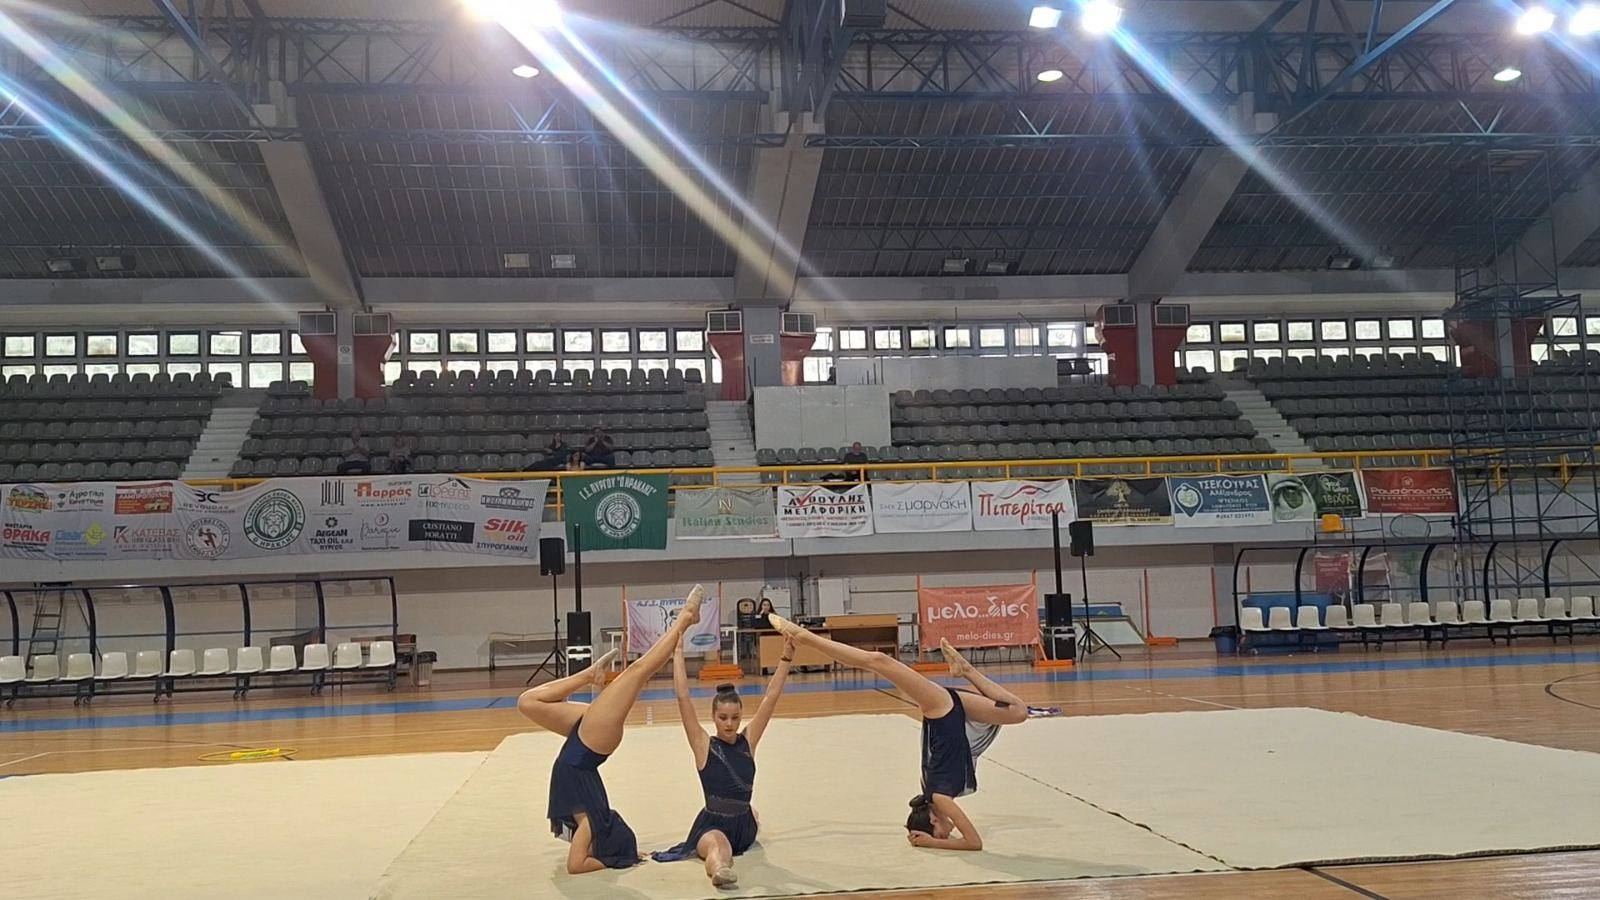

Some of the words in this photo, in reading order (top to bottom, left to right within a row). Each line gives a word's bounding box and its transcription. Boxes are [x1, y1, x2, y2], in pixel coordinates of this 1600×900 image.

[590, 478, 617, 494] ΠΥΡΓΟΥ
[1198, 479, 1260, 490] ΤΣΕΚΟΥΡΑΣ
[784, 505, 866, 515] ΜΕΤΑΦΟΡΙΚΗ
[484, 518, 528, 534] Silk
[682, 517, 720, 528] Italian
[3, 529, 51, 543] ΘΡΑΚΑ
[315, 529, 348, 538] AEGEAN
[507, 533, 525, 542] oil
[659, 598, 687, 607] ΠΥΡΓΟ
